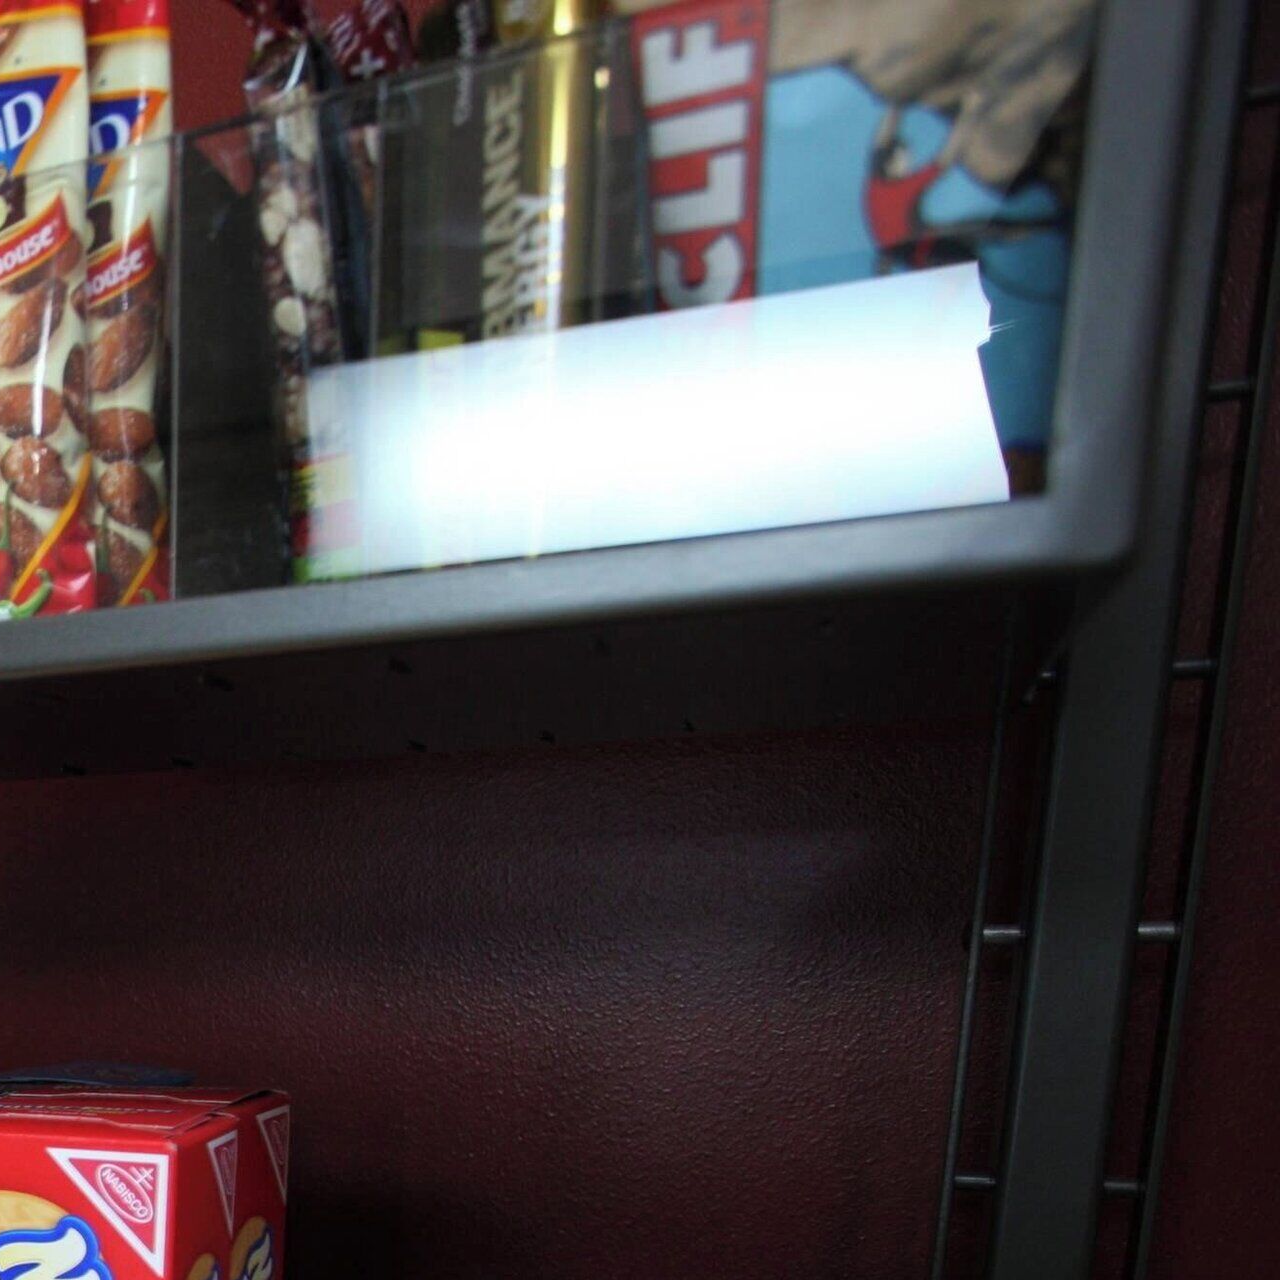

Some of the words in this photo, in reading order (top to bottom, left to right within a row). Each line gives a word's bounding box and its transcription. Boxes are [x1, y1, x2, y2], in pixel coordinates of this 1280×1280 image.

[482, 70, 523, 340] RMANCE
[642, 20, 756, 308] CLIF
[101, 1166, 152, 1221] NABISCO
